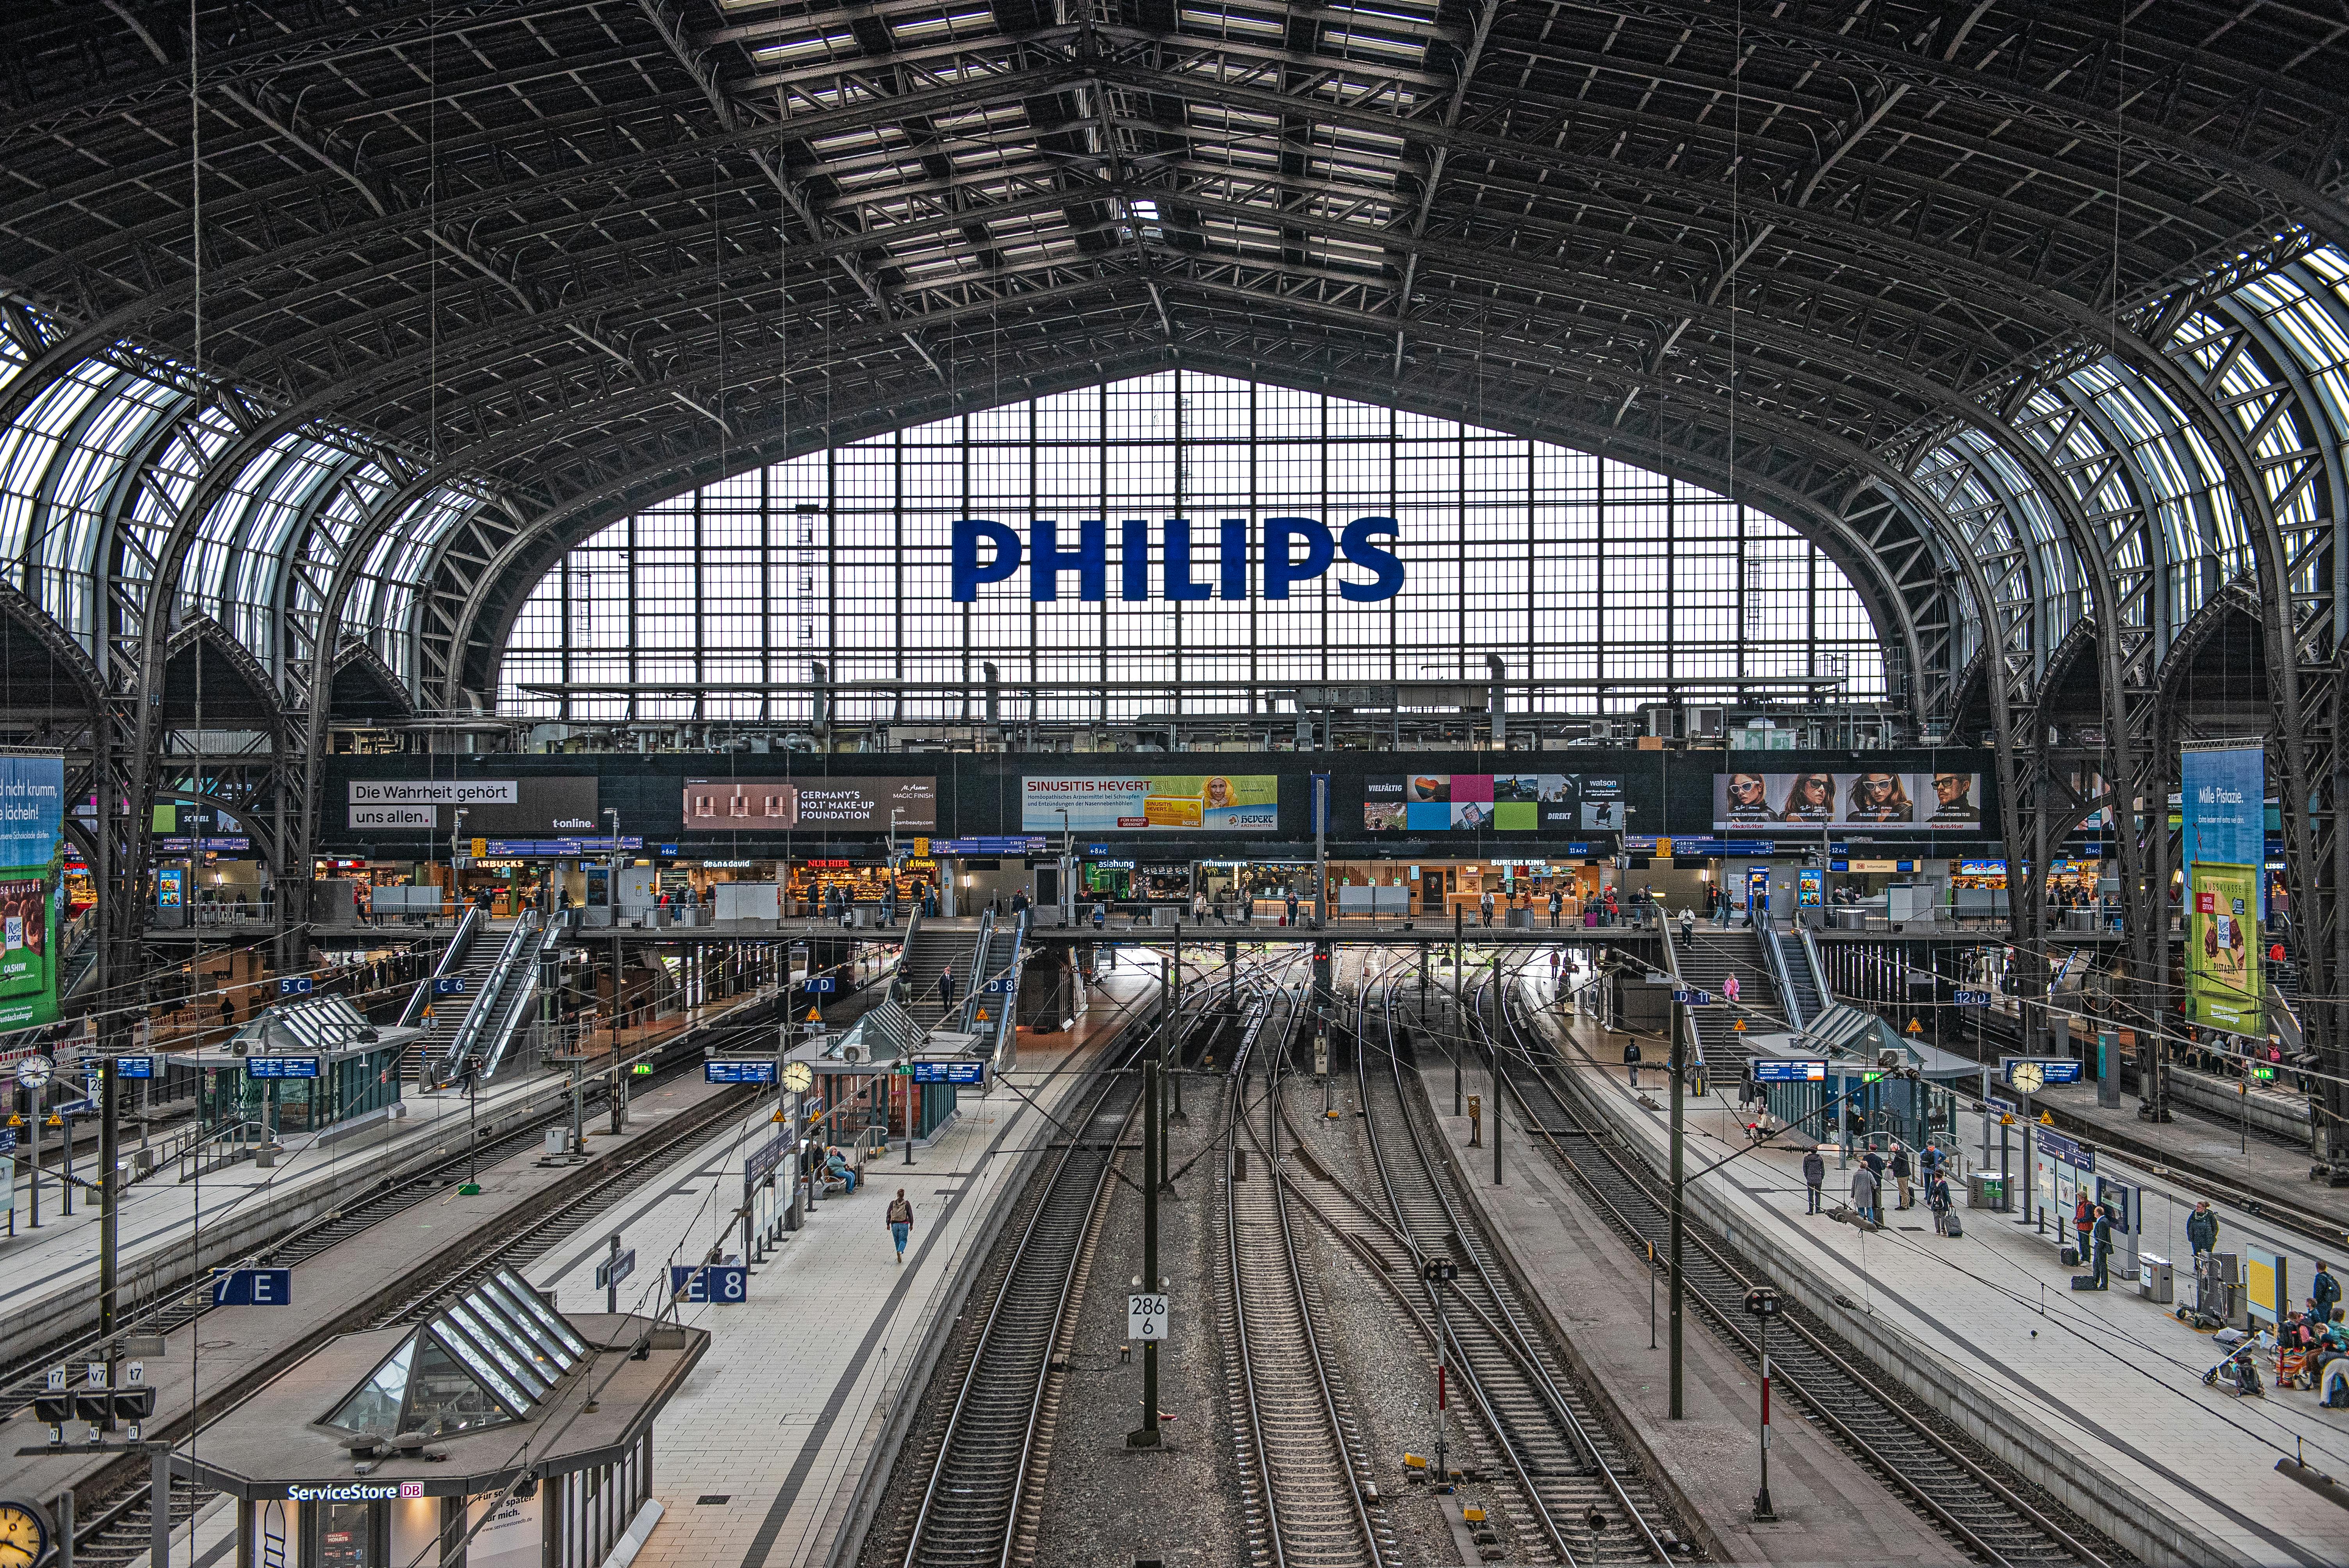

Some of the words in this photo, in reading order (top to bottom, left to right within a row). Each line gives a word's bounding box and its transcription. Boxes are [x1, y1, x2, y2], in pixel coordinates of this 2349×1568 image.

[952, 517, 1404, 602] PHILIPS
[6, 779, 25, 796] nicht
[28, 779, 57, 799] krumm,
[1027, 781, 1094, 791] SINUSITIS
[1098, 781, 1152, 791] HEVERT
[356, 786, 380, 799] Die
[383, 786, 452, 798] Wahrheit
[457, 786, 508, 802] gehört
[2199, 786, 2215, 804] Mille
[2217, 787, 2244, 804] Pistazie.
[5, 802, 38, 820] lächeln!
[356, 813, 383, 823] uns
[387, 810, 428, 823] allen.
[552, 818, 594, 828] t-online.
[1241, 815, 1273, 823] HEVERT
[1099, 859, 1134, 869] asiahung
[2204, 882, 2242, 893] NUSSKLASSE
[8, 922, 21, 934] Ritter
[2218, 919, 2229, 933] Ritter
[2214, 962, 2235, 975] PISTAZIE
[282, 981, 289, 992] 5
[298, 980, 305, 992] C
[440, 980, 448, 991] C
[456, 980, 463, 991] 6
[806, 980, 813, 991] 7
[821, 980, 829, 990] D
[991, 980, 999, 991] D
[1006, 980, 1014, 991] 8
[1680, 992, 1688, 1002] D
[1698, 992, 1709, 1002] 11
[1957, 992, 1969, 1003] 12
[1977, 993, 1986, 1004] D
[217, 1276, 233, 1301] 7
[255, 1275, 272, 1301] E
[688, 1272, 704, 1298] E
[724, 1272, 742, 1298] 8
[1132, 1297, 1165, 1315] 286
[1142, 1318, 1154, 1335] 6
[52, 1372, 63, 1383] r7
[91, 1370, 106, 1381] v7
[130, 1368, 142, 1380] t7
[50, 1429, 58, 1440] r7
[91, 1428, 98, 1438] v7
[130, 1427, 137, 1437] t7
[289, 1484, 397, 1500] ServiceStore
[404, 1485, 420, 1496] DB
[478, 1490, 492, 1501] Für
[506, 1494, 534, 1507] später.
[498, 1509, 520, 1520] mich.
[481, 1516, 532, 1534] www.servicestoredb.de
